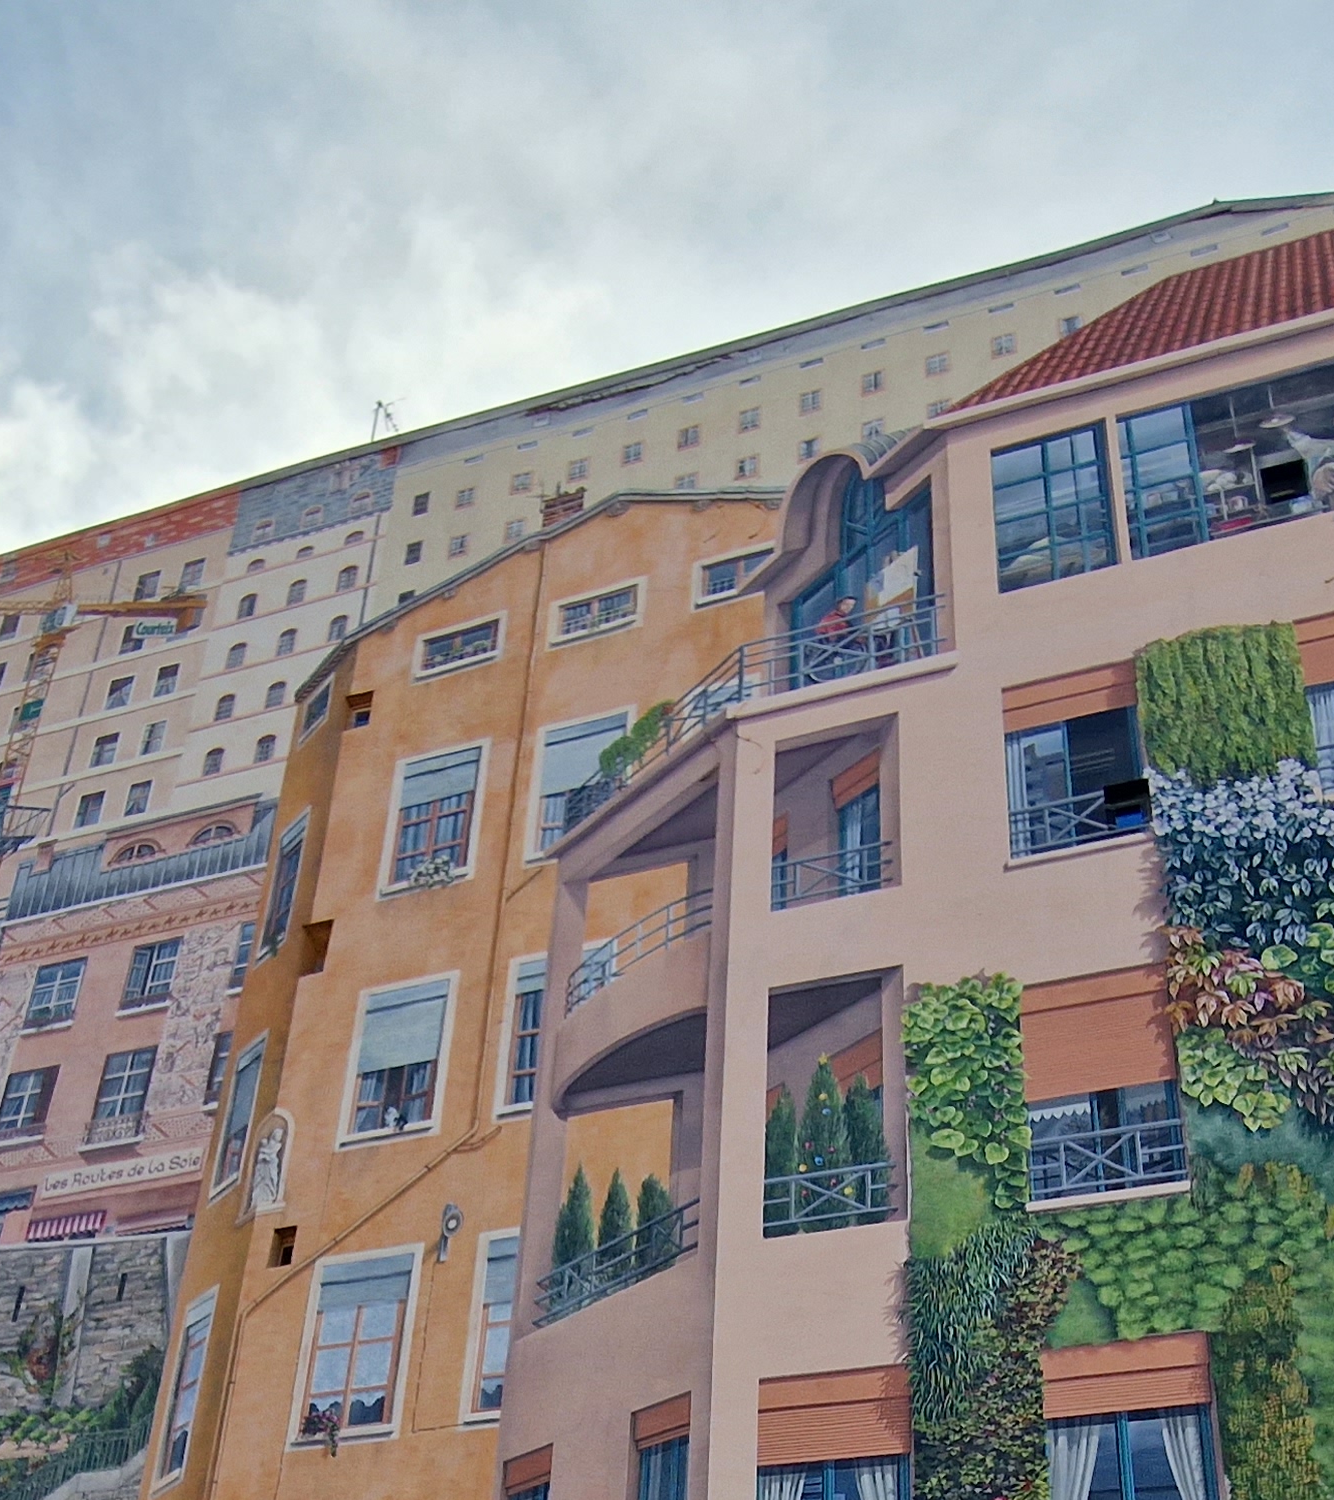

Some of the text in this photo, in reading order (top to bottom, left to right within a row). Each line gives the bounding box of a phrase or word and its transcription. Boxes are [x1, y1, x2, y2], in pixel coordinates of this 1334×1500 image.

[44, 1175, 68, 1192] Les
[71, 1168, 123, 1187] Routes
[127, 1164, 144, 1178] de
[168, 1153, 201, 1171] Soie
